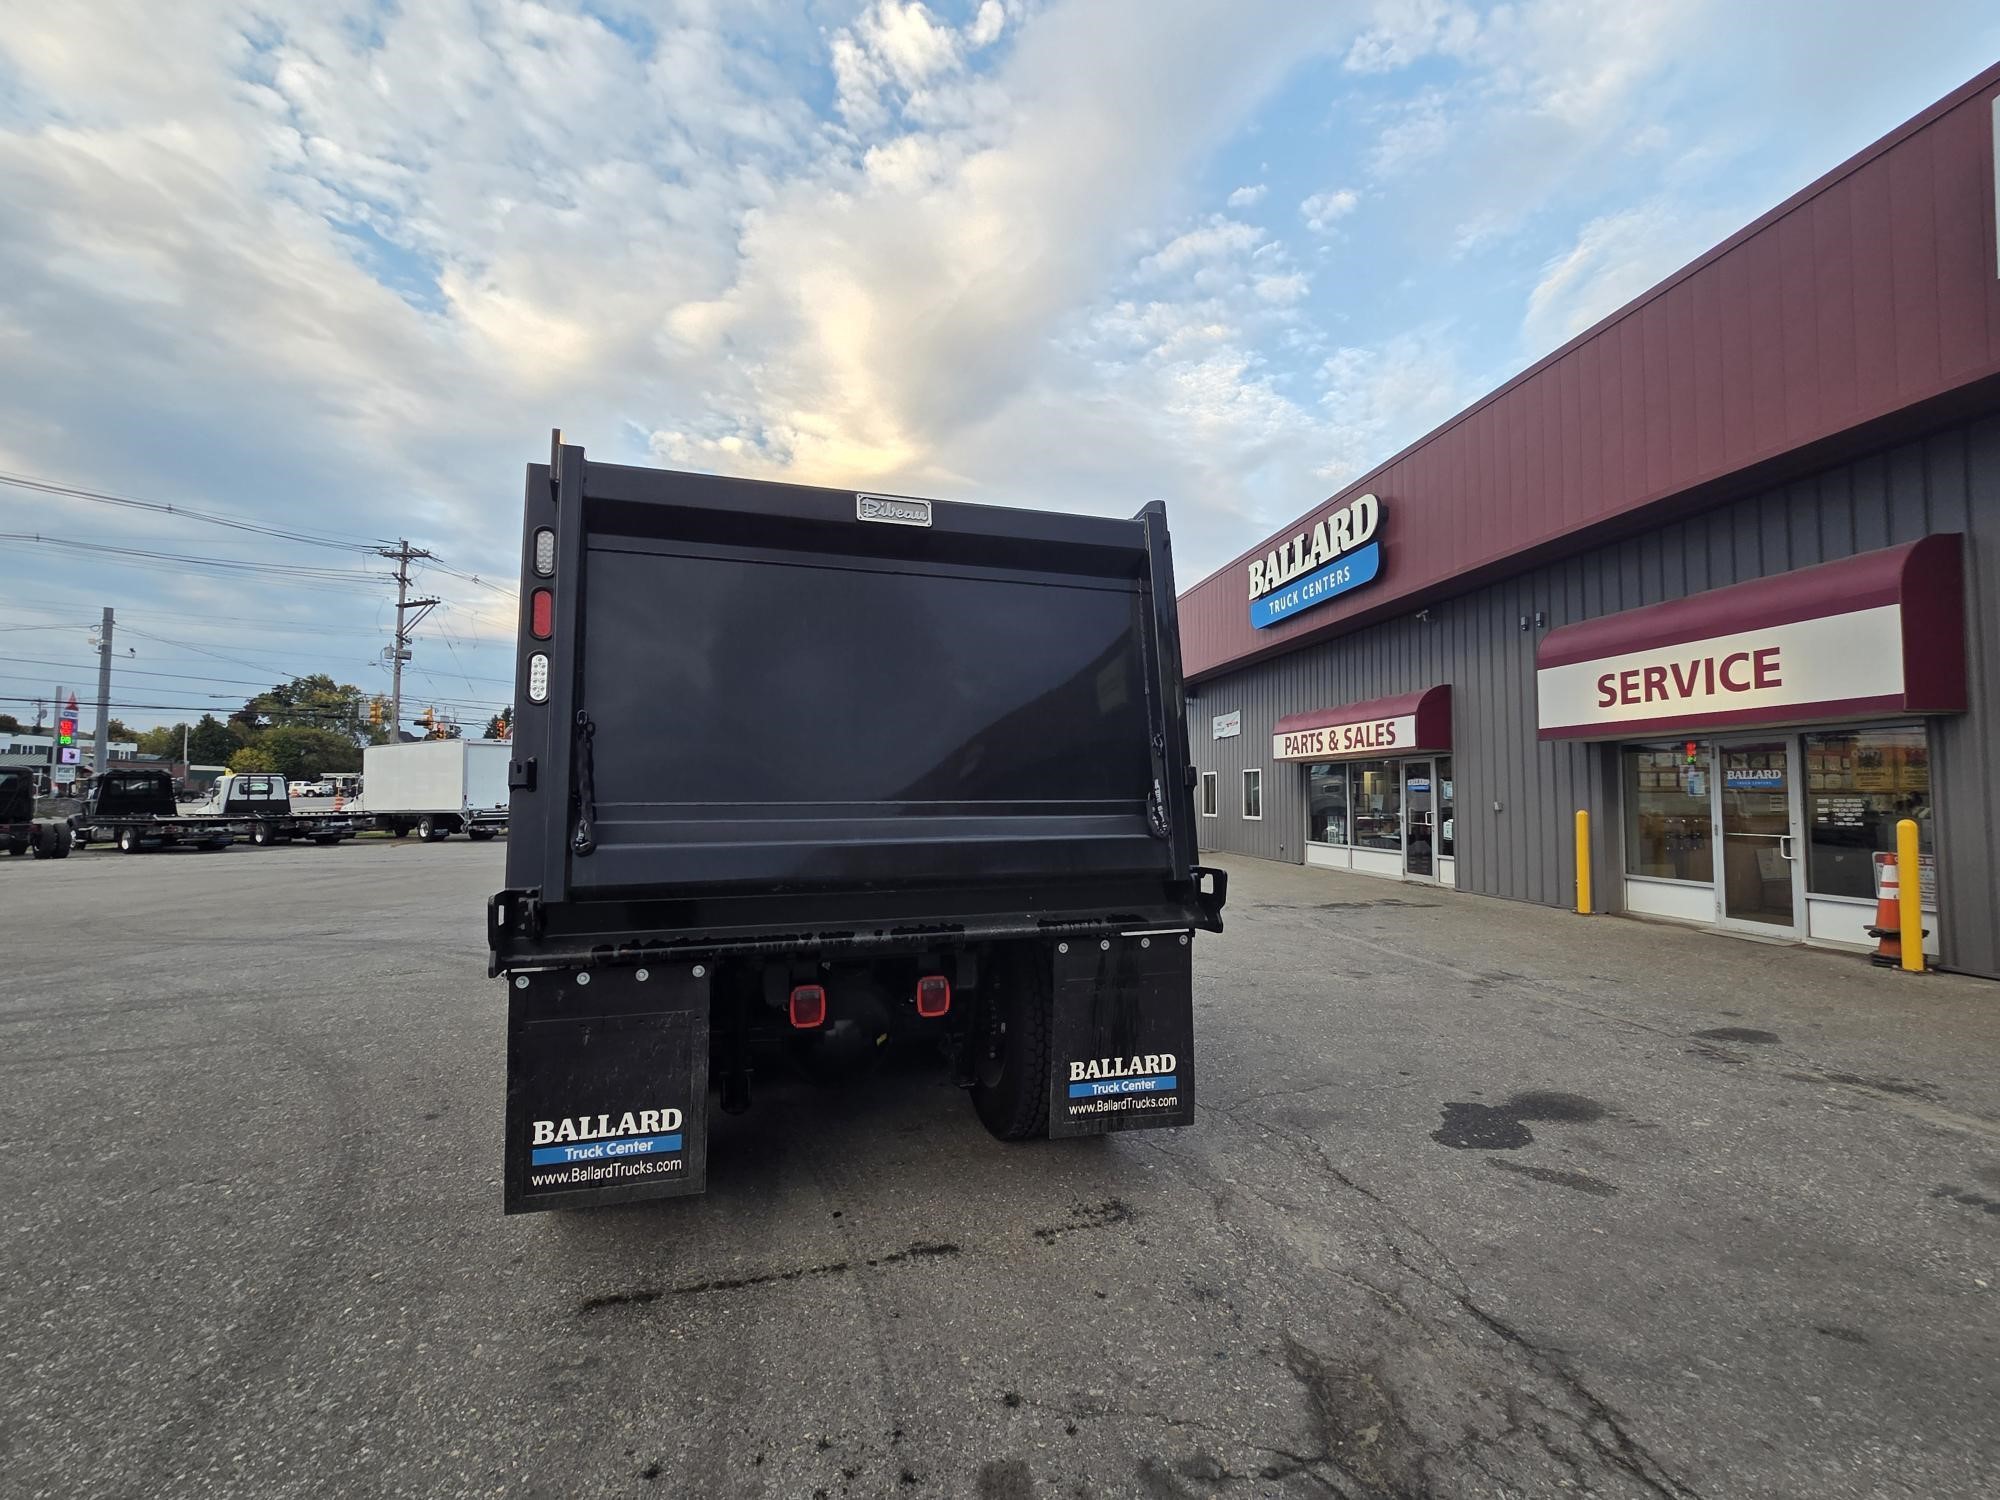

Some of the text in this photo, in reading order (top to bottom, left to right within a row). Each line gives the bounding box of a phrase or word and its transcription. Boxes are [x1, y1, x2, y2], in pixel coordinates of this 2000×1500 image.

[861, 498, 928, 521] Bibeau
[1248, 493, 1379, 601] BALLARD
[1268, 566, 1351, 615] TRUCK CENTERS
[1597, 646, 1782, 708] SERVICE
[1284, 721, 1396, 755] PARTS & SALES
[1727, 770, 1782, 780] BALLARD
[1069, 1053, 1177, 1081] BALLARD
[1092, 1080, 1156, 1095] Truck Center
[1068, 1096, 1178, 1115] www.BallardTrucks.com
[532, 1108, 683, 1145] BALLARD
[565, 1140, 654, 1161] Truck Center
[531, 1159, 682, 1187] www.BallardTrucks.com
